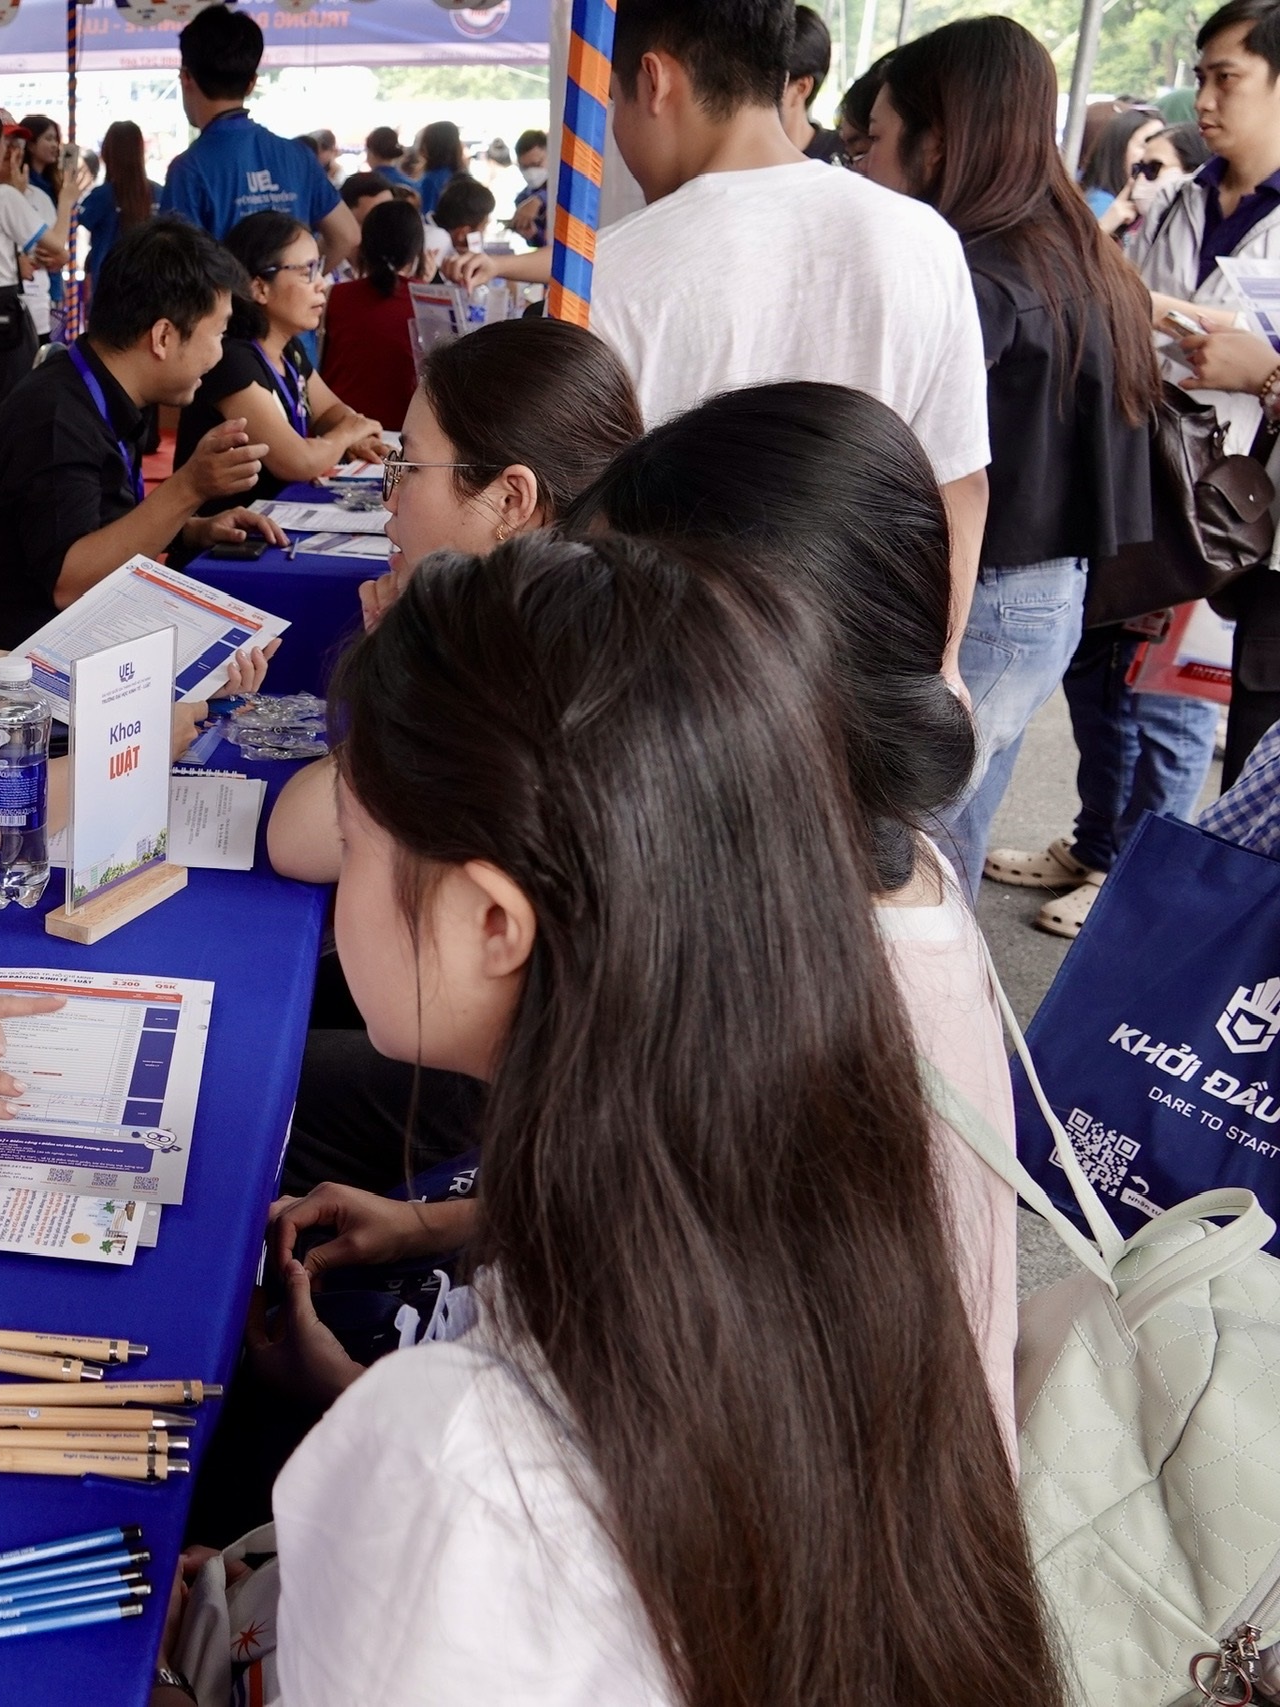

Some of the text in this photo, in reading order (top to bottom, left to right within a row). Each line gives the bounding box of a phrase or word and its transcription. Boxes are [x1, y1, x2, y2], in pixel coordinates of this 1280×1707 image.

[119, 661, 135, 679] UEL
[110, 720, 141, 745] Khoa
[110, 745, 140, 780] LUẬT
[1108, 1022, 1280, 1124] KHỞI ĐẦU
[1148, 1086, 1280, 1159] DARE TO START
